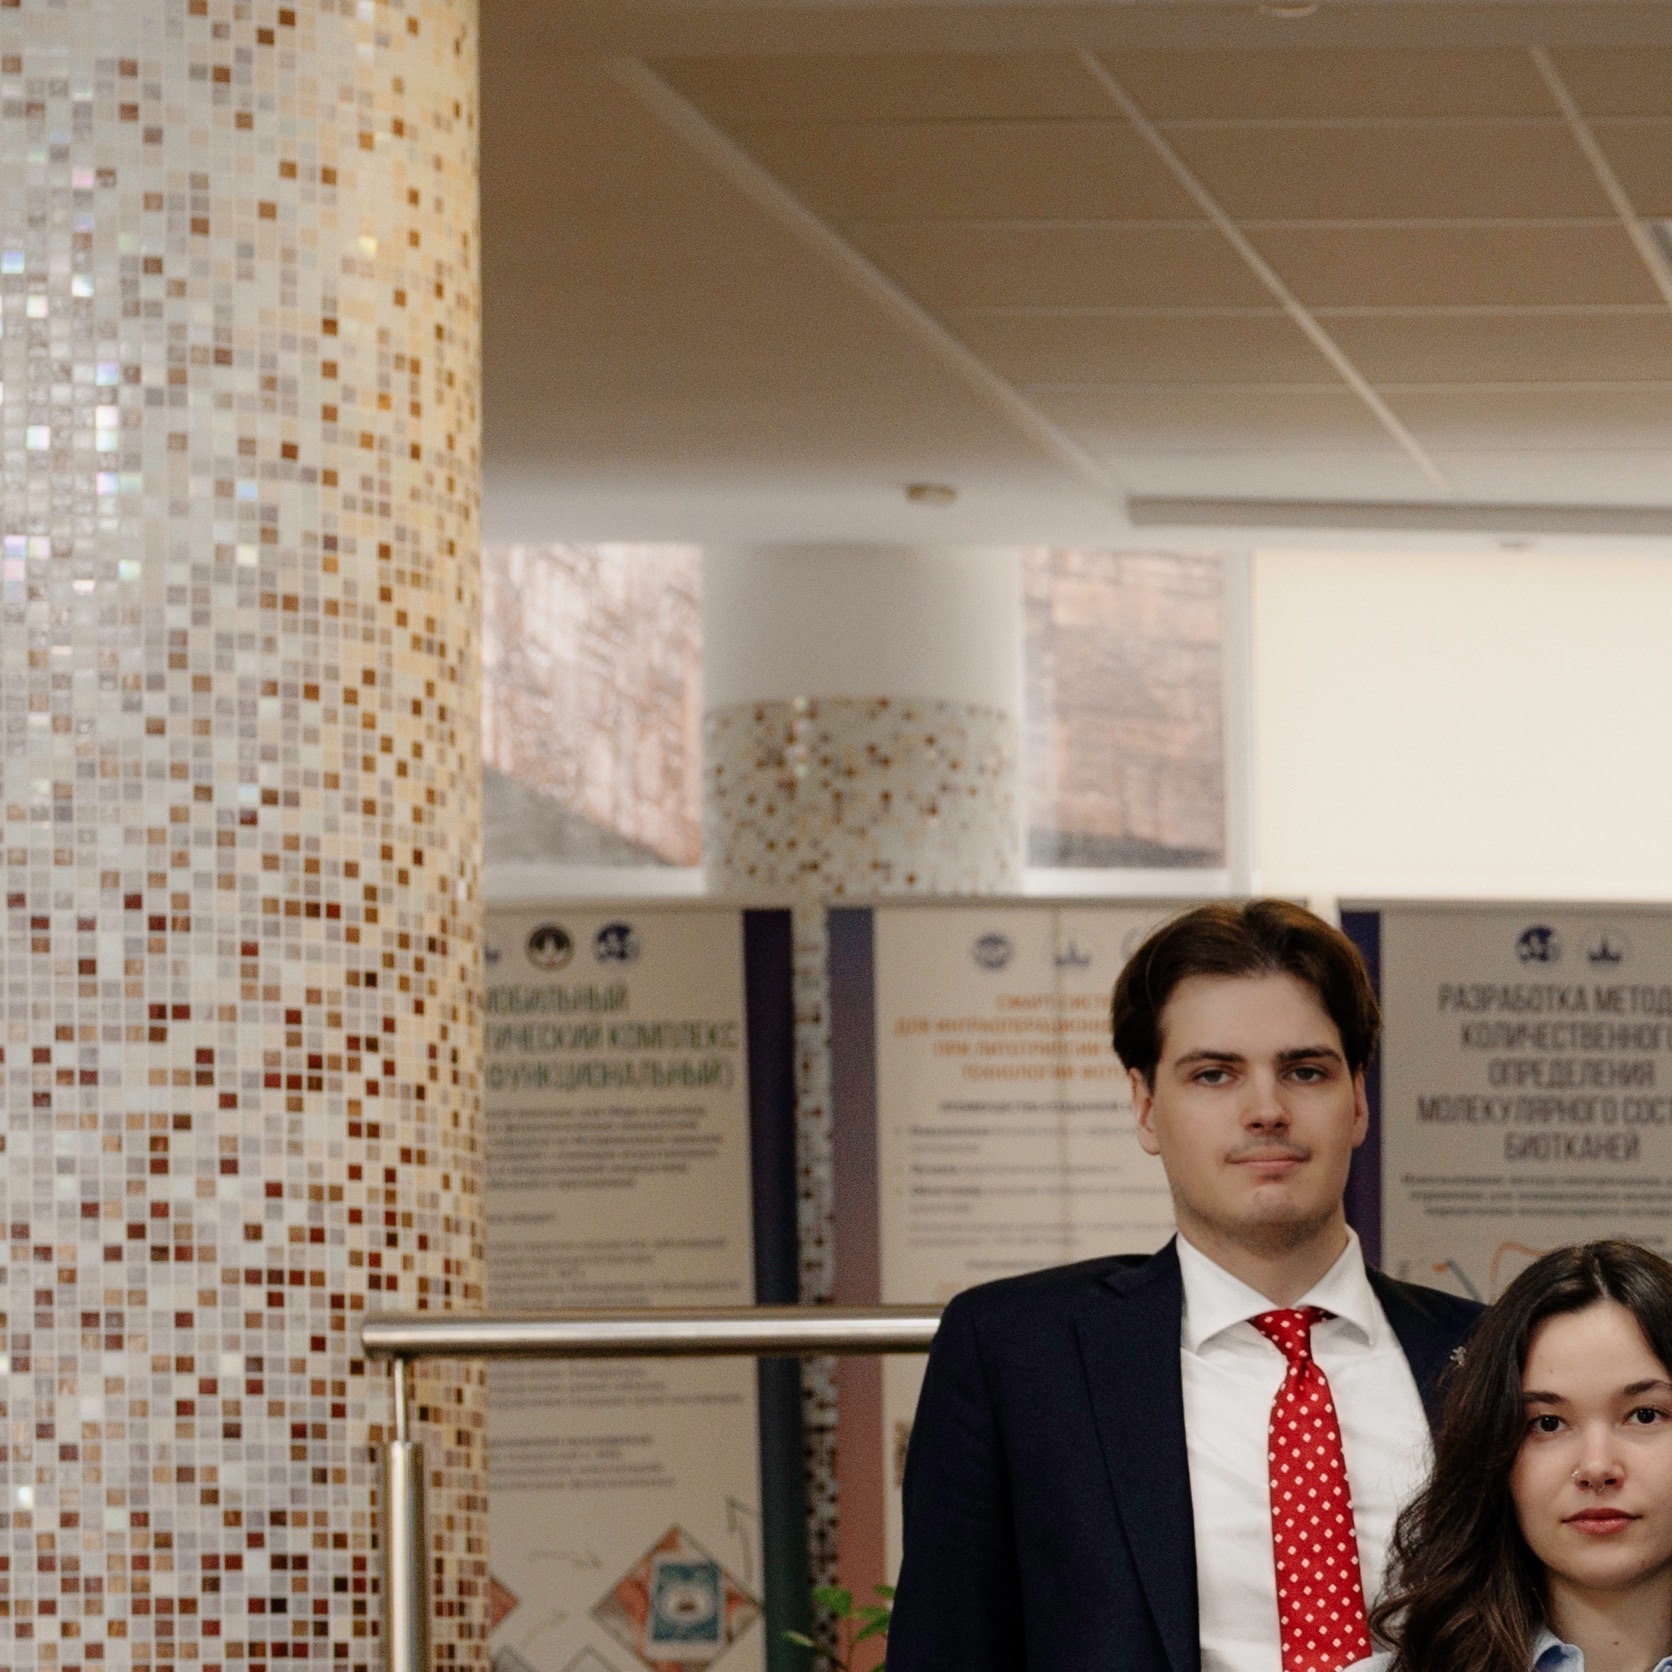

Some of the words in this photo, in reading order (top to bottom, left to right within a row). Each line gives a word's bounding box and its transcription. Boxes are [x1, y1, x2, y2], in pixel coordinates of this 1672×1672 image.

[1438, 983, 1587, 1014] РАЗРАБОТКА
[609, 1020, 738, 1050] КОМПЛЕКС
[1488, 1059, 1655, 1089] ОПРЕДЕЛЕНИЯ
[1416, 1095, 1617, 1125] МОЛЕКУЛЯРНОГО
[1504, 1129, 1641, 1162] БИОТКАНЕЙ
